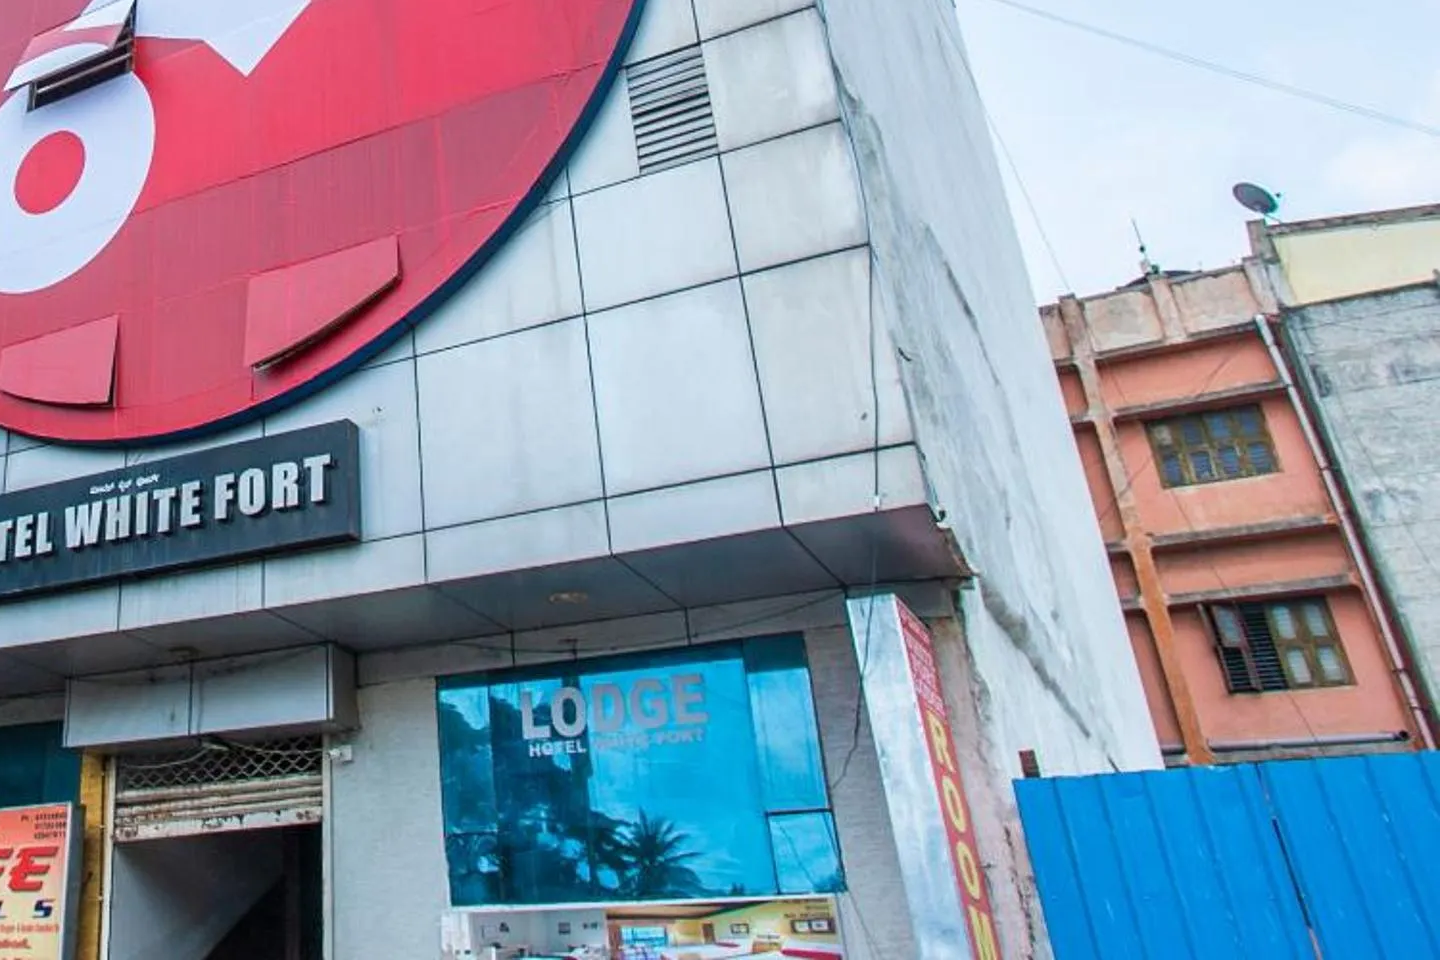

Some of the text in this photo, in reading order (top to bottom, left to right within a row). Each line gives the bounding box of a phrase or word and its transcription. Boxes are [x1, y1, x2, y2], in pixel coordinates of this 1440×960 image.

[64, 479, 201, 549] WHITE
[213, 453, 333, 521] FORT
[519, 672, 709, 740] LODGE
[528, 739, 587, 758] HOTEL
